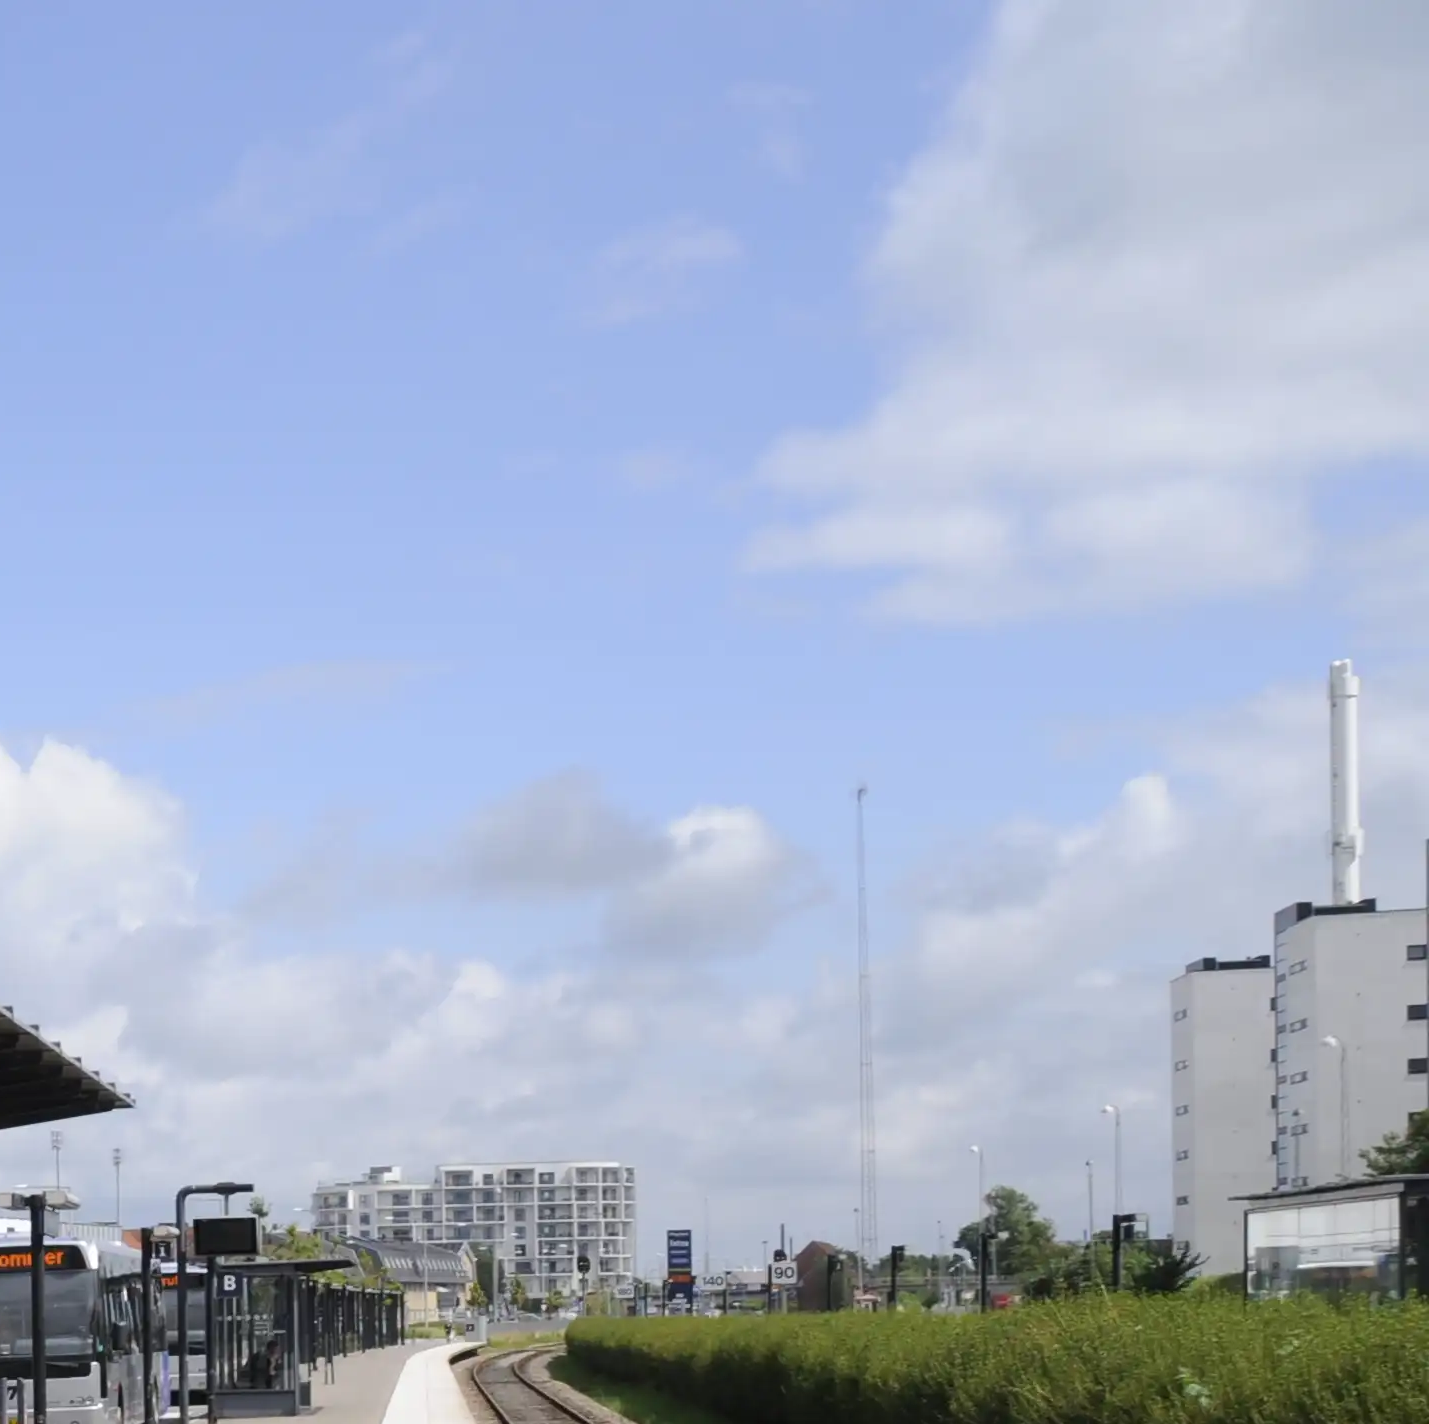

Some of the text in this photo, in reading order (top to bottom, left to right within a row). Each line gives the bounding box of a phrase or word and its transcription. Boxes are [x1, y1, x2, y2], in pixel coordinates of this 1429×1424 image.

[774, 1266, 795, 1279] 90
[223, 1274, 237, 1291] B
[703, 1275, 724, 1287] 140
